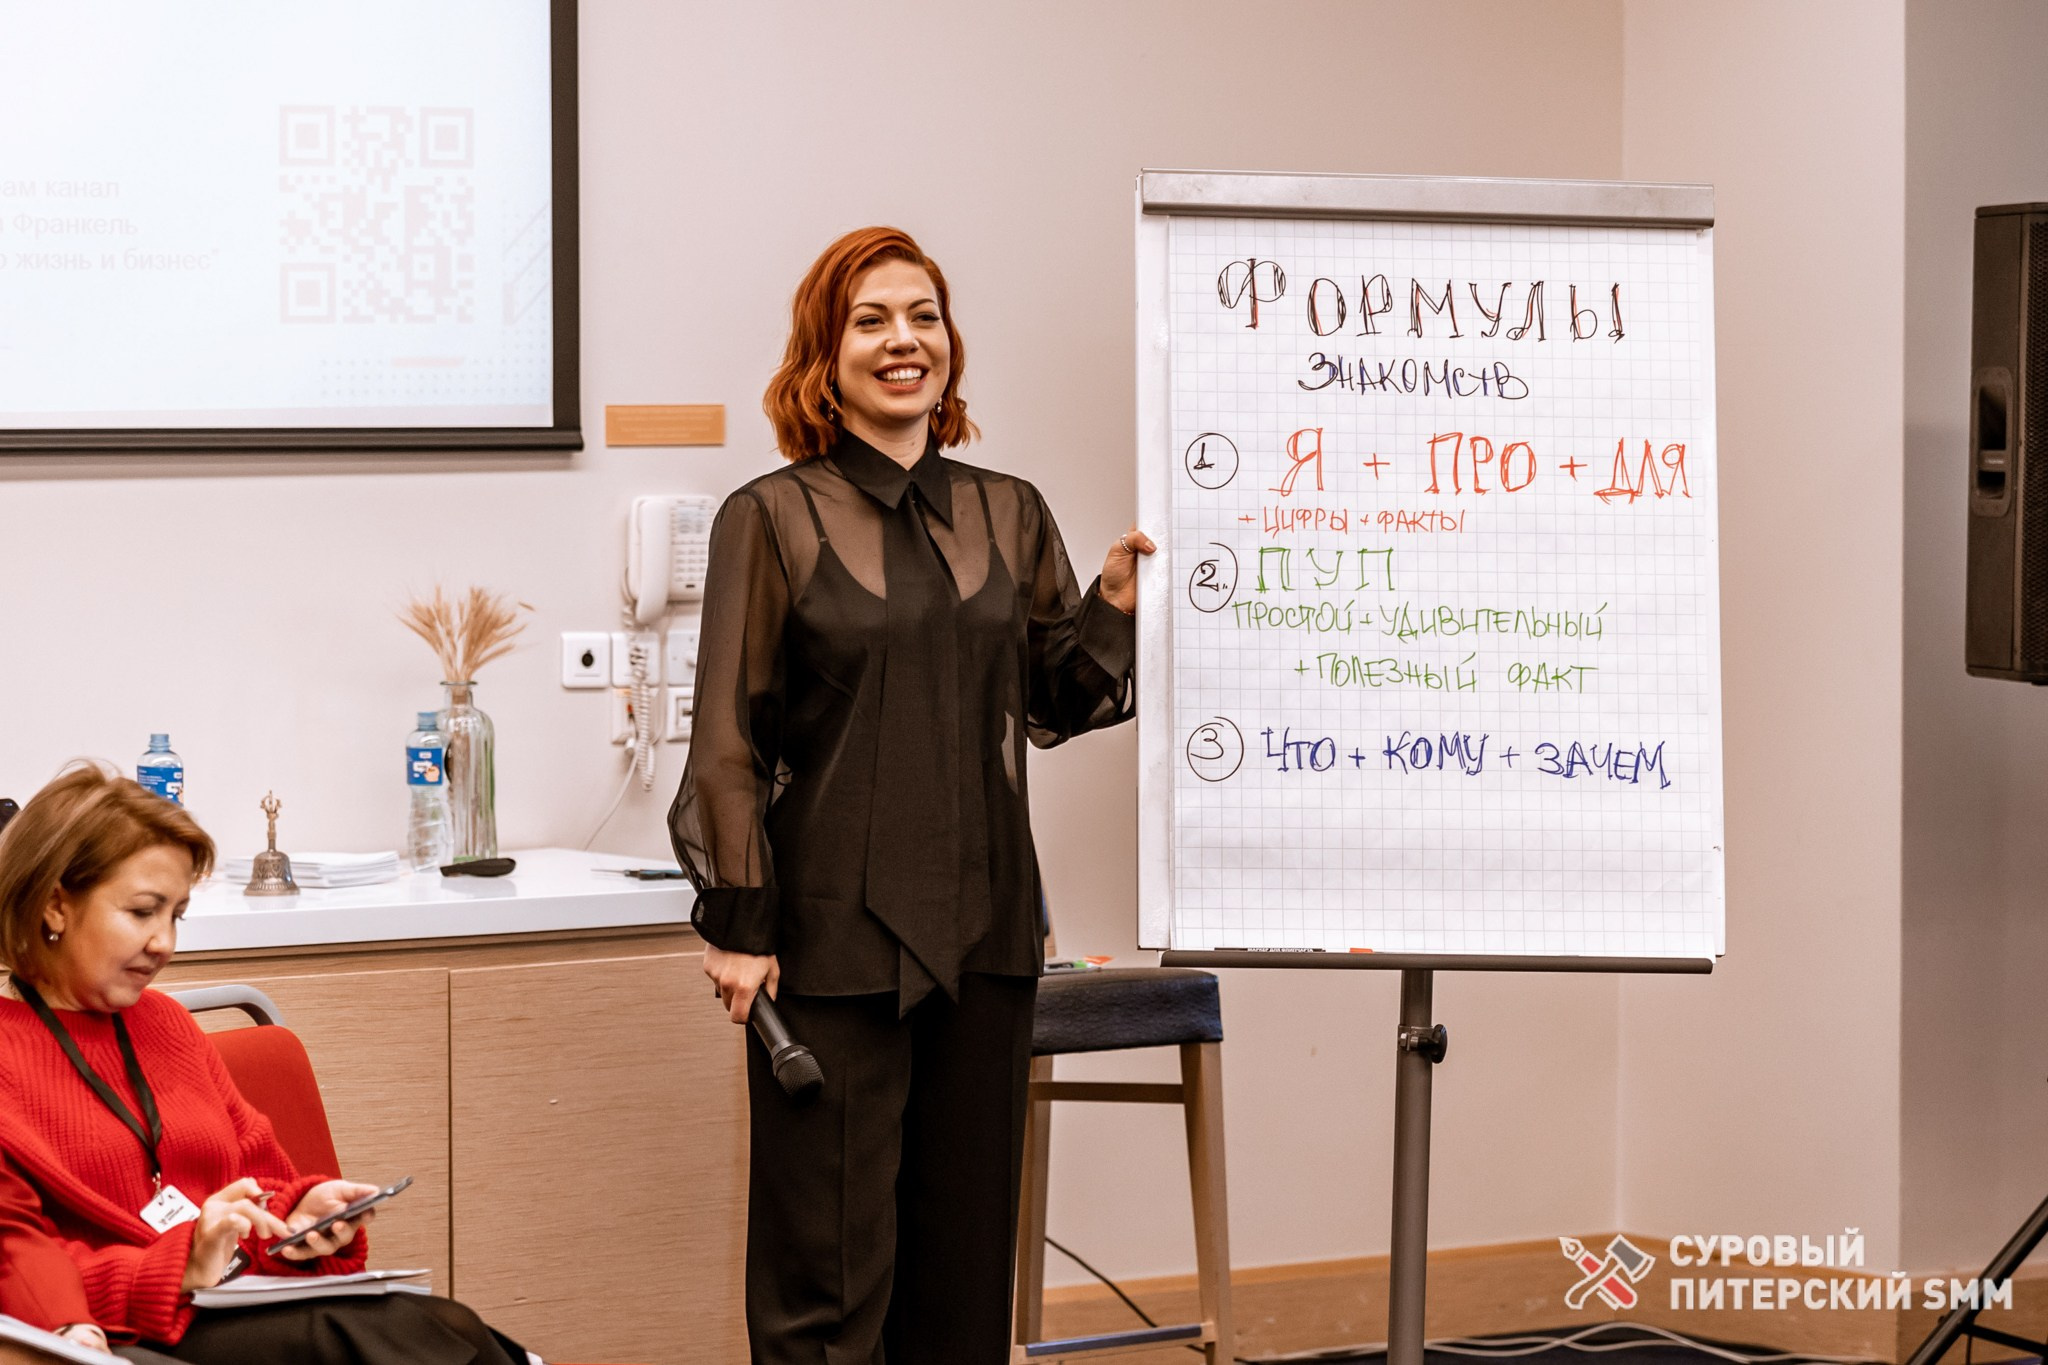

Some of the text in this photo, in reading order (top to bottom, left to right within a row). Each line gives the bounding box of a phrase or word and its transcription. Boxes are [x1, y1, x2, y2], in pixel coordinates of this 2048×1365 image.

[0, 180, 120, 198] ам канал
[12, 212, 139, 240] Франкель
[16, 253, 92, 270] жизнь
[101, 253, 115, 270] и
[1216, 257, 1626, 344] ФОРМУЛЫ
[1298, 352, 1529, 400] ЗНАКОМСТВ
[1268, 427, 1324, 497] Я
[1363, 453, 1391, 480] +
[1425, 431, 1537, 495] ПРО
[1559, 455, 1587, 480] +
[1594, 437, 1692, 505] ДЛЯ
[1264, 506, 1348, 539] ЦИФРЫ
[1377, 509, 1465, 533] ФАКТЫ
[1255, 546, 1396, 594] ПУП
[1232, 600, 1355, 634] ПРОСТОЙ
[1380, 601, 1608, 644] УДИВИТЕЛЬНЫЙ
[1316, 652, 1476, 691] ПОЛЕЗНЫЙ
[1508, 662, 1599, 693] ФАКТ
[1260, 726, 1336, 773] ЧТО
[1348, 747, 1366, 768] +
[1382, 730, 1489, 776] КОМУ
[1499, 746, 1520, 769] +
[1534, 740, 1671, 790] ЗАЧЕМ
